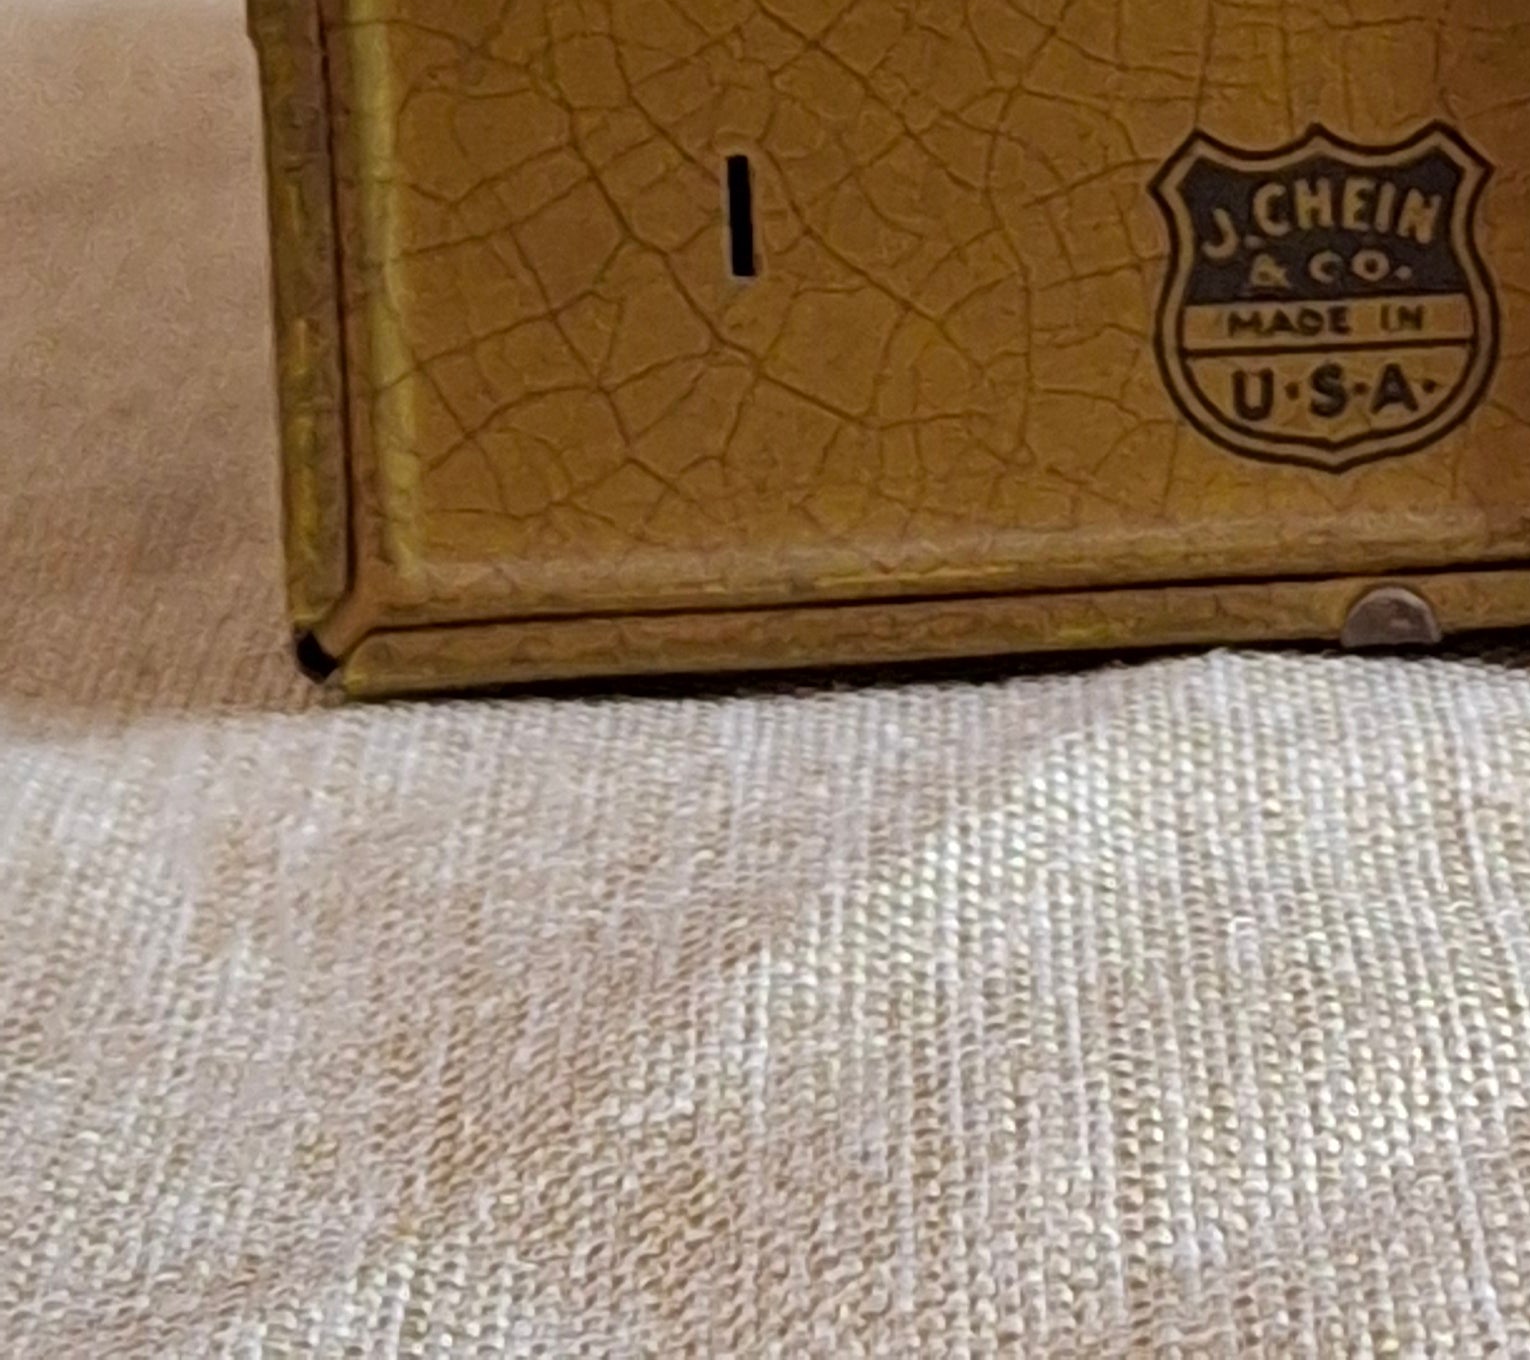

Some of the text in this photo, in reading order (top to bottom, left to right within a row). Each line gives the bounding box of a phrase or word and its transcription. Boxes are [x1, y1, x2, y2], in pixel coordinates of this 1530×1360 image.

[1202, 176, 1441, 259] J. CHEIN
[1247, 249, 1413, 288] & CO.
[1227, 303, 1425, 338] MADE IN
